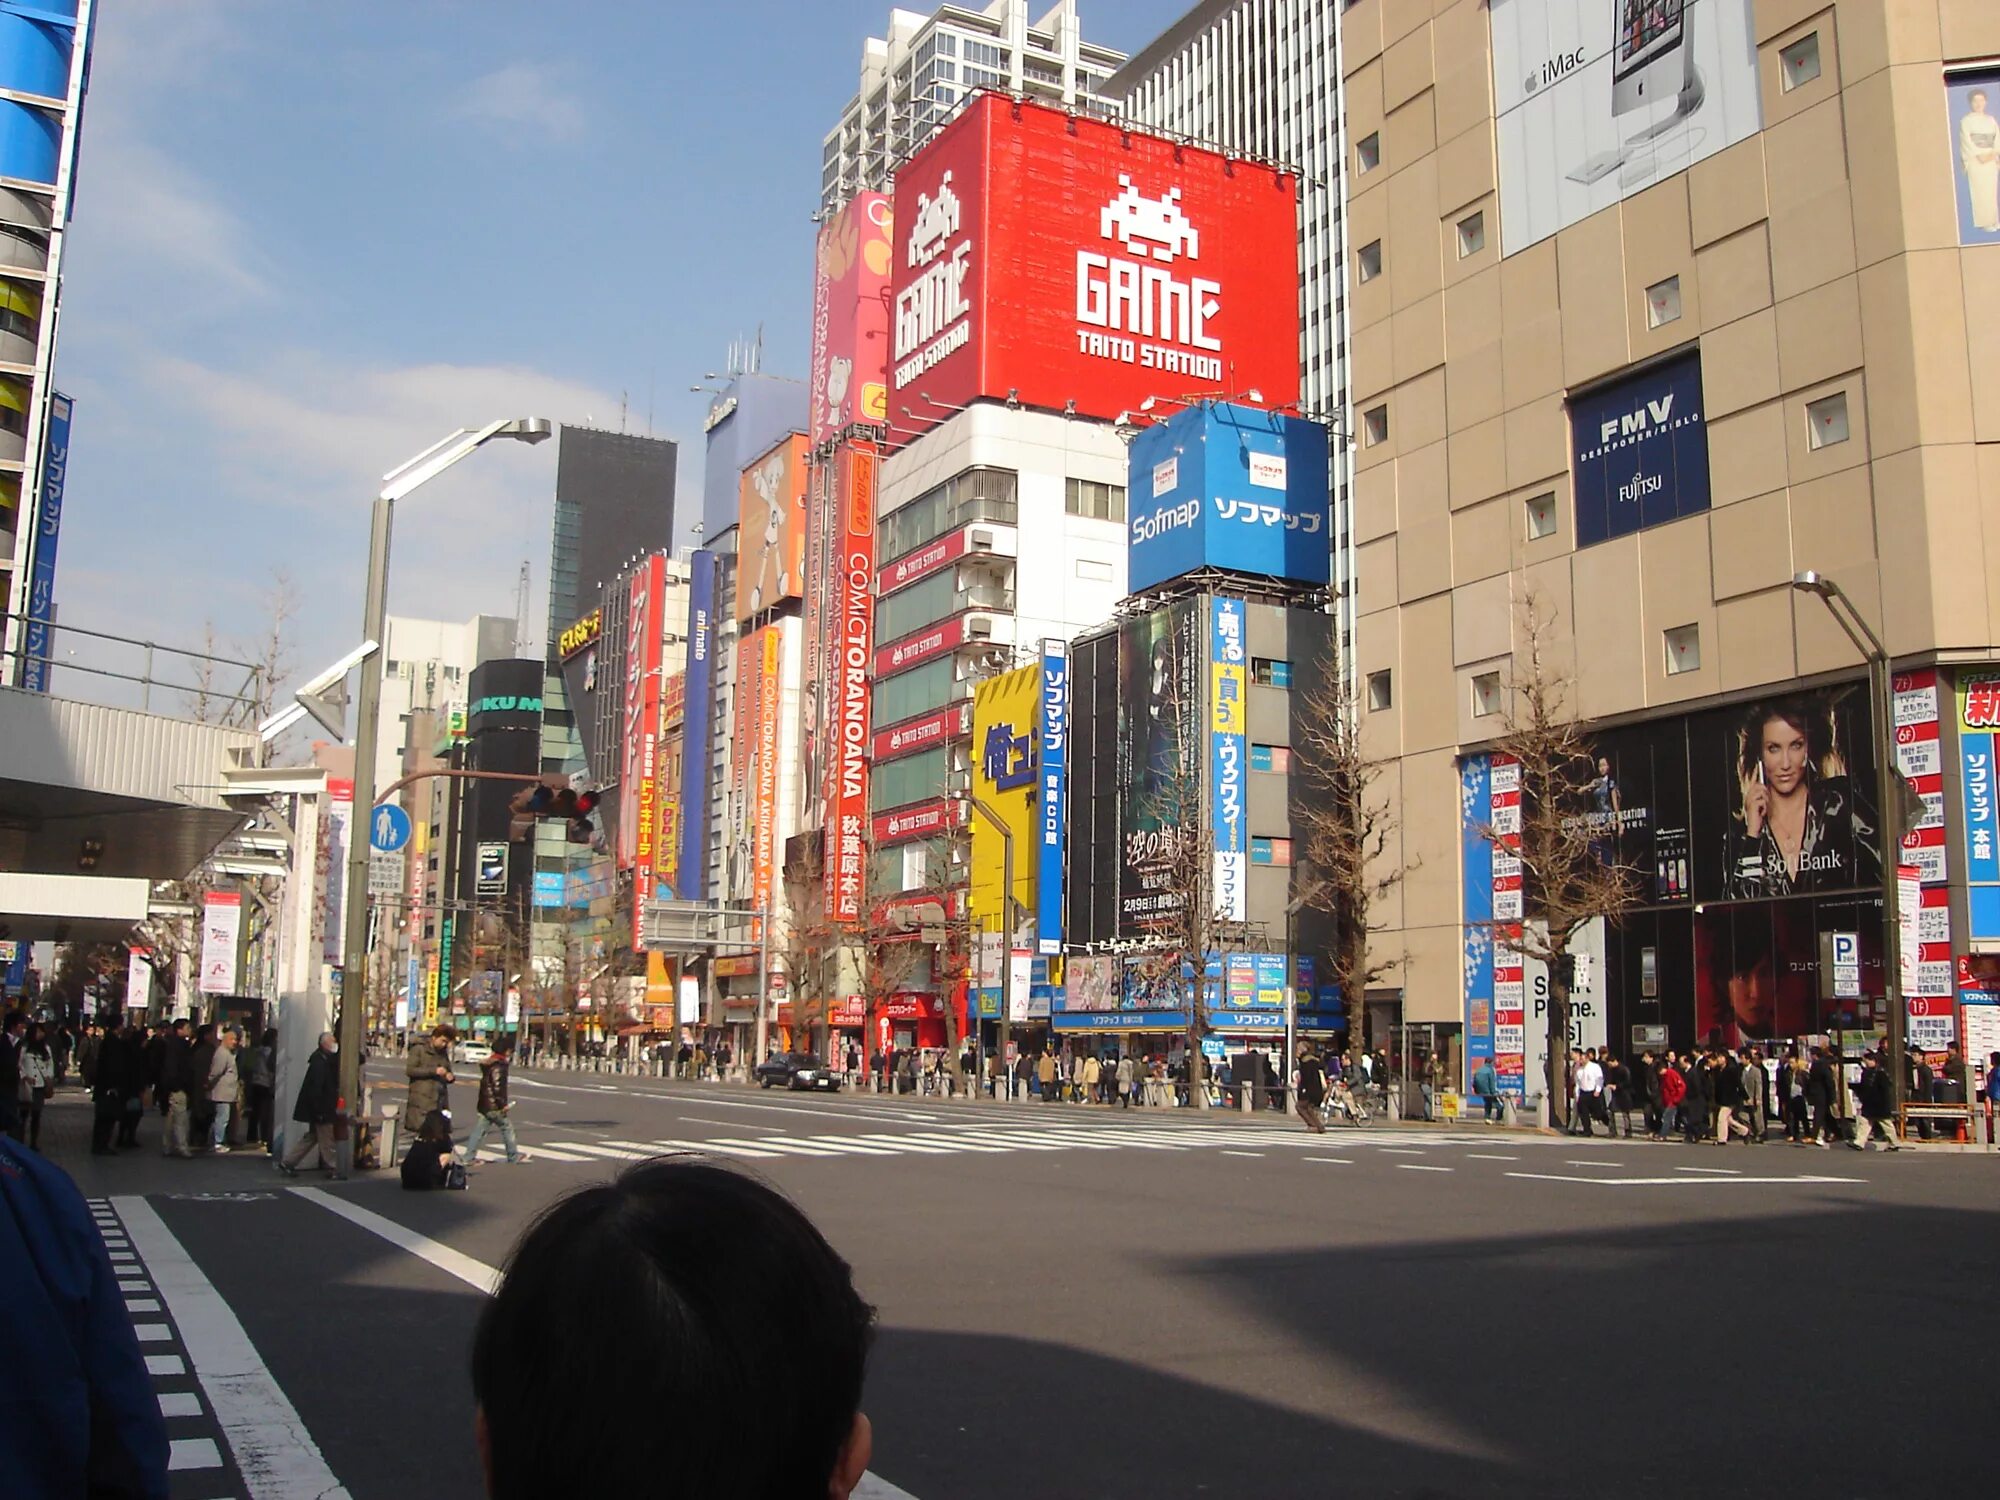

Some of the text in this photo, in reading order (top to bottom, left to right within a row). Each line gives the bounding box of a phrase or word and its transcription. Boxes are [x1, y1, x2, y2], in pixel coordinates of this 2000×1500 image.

[1541, 45, 1586, 86] iMac
[895, 241, 971, 361] GAME
[1076, 250, 1221, 352] GAME
[894, 320, 970, 390] TAITO STATION
[1076, 329, 1222, 382] TAITO STATION
[1580, 413, 1699, 463] DESKPOWER/BIBLO
[1601, 393, 1675, 444] FMV
[43, 442, 67, 536] ソフマップ
[1618, 472, 1662, 502] FUJITSU
[1132, 499, 1200, 545] Sofmap
[1214, 497, 1321, 534] ソフマップ
[906, 545, 946, 575] TAITO STATION
[695, 609, 708, 662] animate
[903, 633, 943, 660] TAITO STATION
[1217, 612, 1243, 661] 売る
[843, 552, 870, 799] COMICTORANOANA
[1216, 676, 1238, 723] 買う
[1895, 678, 1909, 689] 7F
[1044, 670, 1065, 750] ソフマップ
[1902, 703, 1930, 713] おもちゃ
[760, 677, 776, 797] COMICTORANOANA
[901, 721, 941, 745] TAITO STATION
[1898, 730, 1912, 743] 6F
[1218, 746, 1241, 824] ワクワク
[1967, 754, 1992, 860] ソフマップ 本館
[639, 778, 654, 857] ドン・キホーテ
[758, 800, 772, 868] AKIHABARA
[899, 811, 939, 832] TAITO STATION
[1044, 775, 1059, 845] 音楽CD館
[1903, 833, 1917, 847] 4F
[1904, 851, 1932, 861] パソコン
[839, 814, 861, 915] 秋葉原本店
[1222, 855, 1236, 917] ソフマップ
[1836, 937, 1852, 962] P
[1092, 1015, 1120, 1025] ソフマップ
[1233, 1014, 1280, 1025] ソフマップ
[1534, 1000, 1597, 1019] Pne.
[1912, 1000, 1925, 1014] 1F
